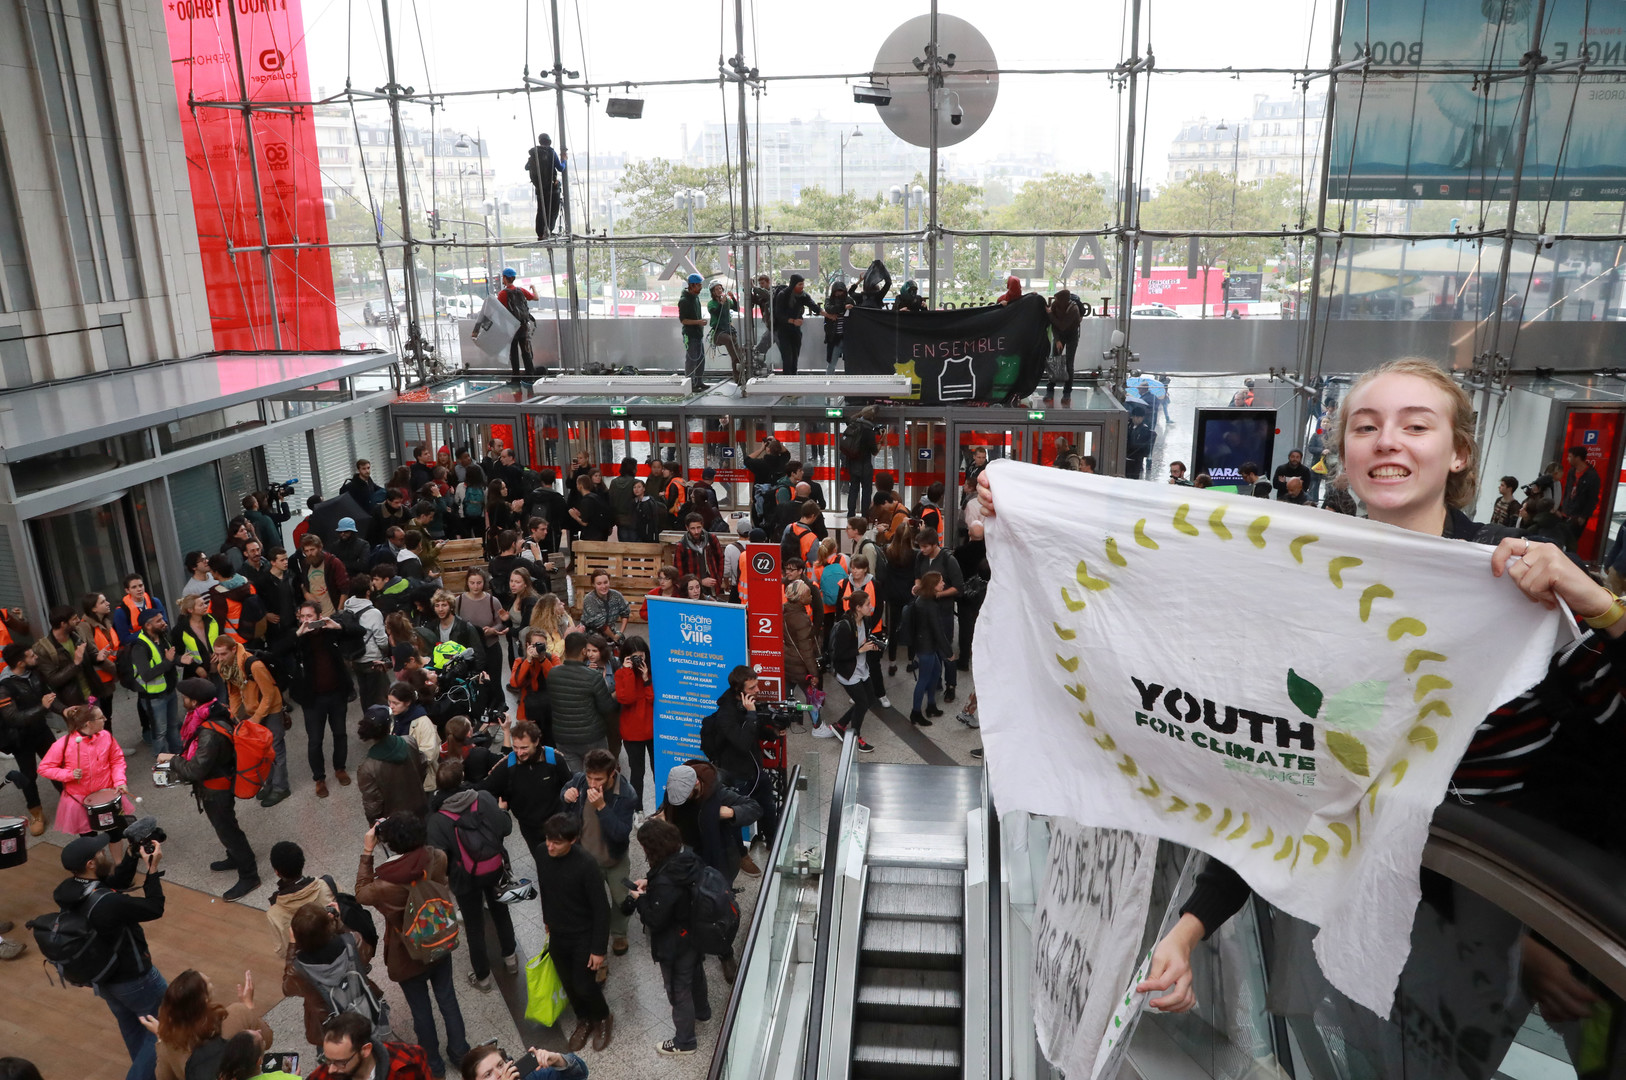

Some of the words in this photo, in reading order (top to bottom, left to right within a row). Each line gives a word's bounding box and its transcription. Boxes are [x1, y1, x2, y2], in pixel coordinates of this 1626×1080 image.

[912, 336, 1006, 359] ENSEMBLE
[1586, 432, 1596, 443] P
[678, 612, 713, 625] Théâtre
[758, 617, 773, 634] 2
[680, 622, 693, 631] de
[694, 622, 703, 632] la
[680, 629, 713, 645] Ville
[670, 648, 685, 656] PRÈS
[693, 651, 708, 659] CHEZ
[672, 657, 699, 666] SPECTACLES
[1131, 675, 1315, 751] YOUTH
[1135, 710, 1186, 742] FOR
[1190, 730, 1316, 771] CLIMATE
